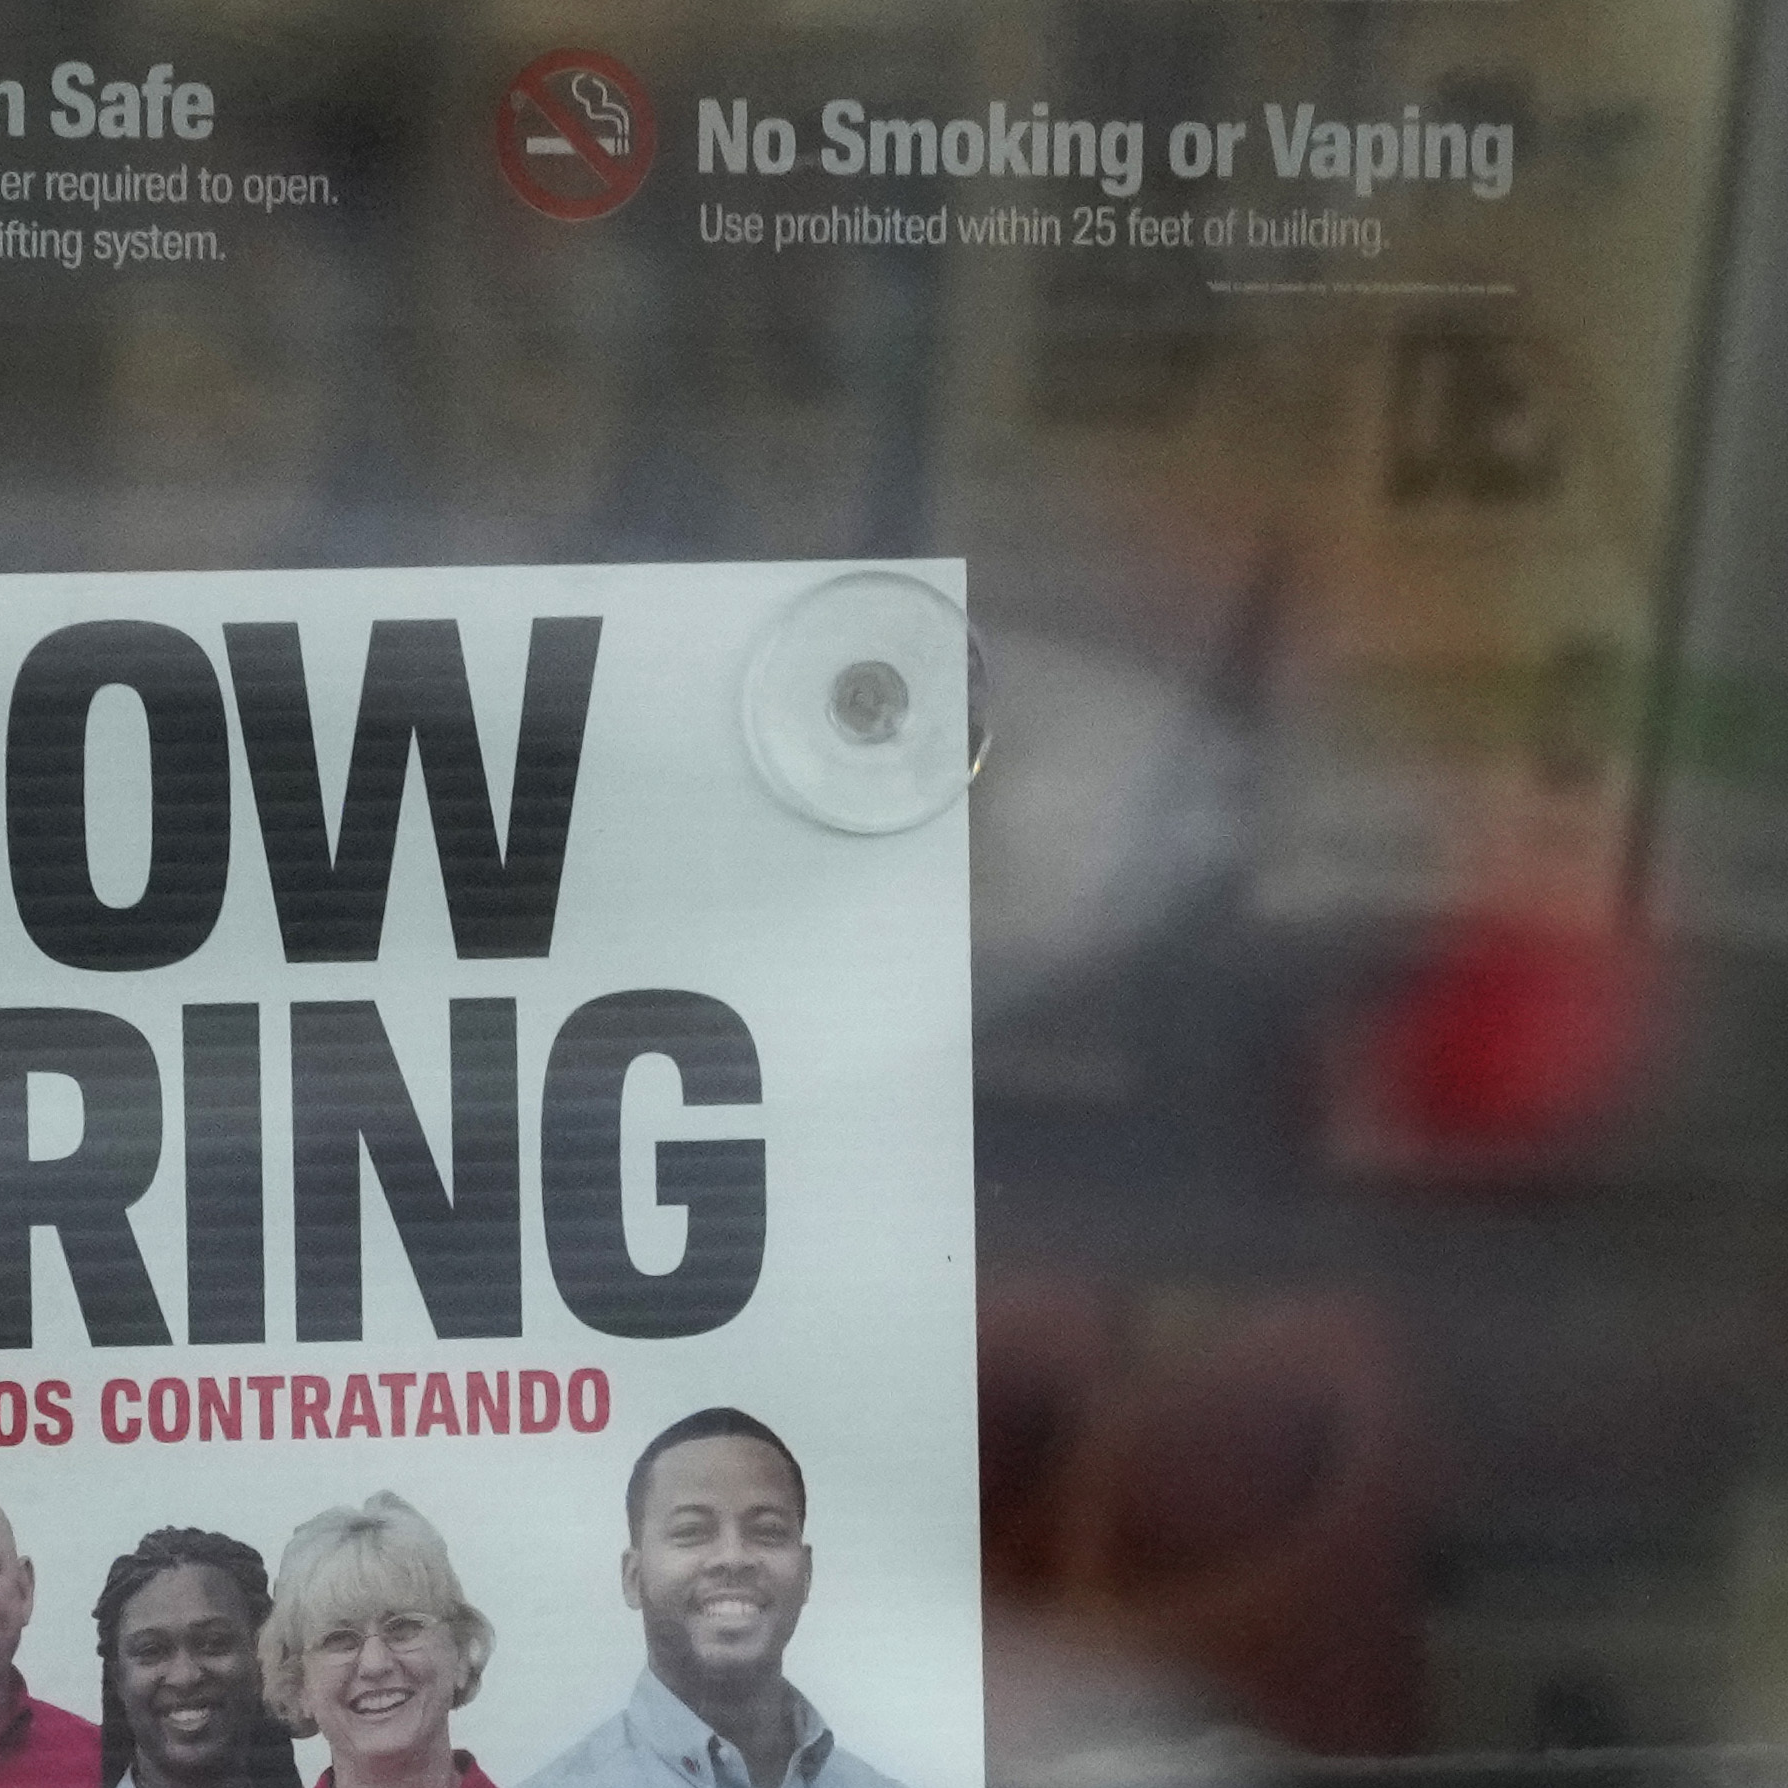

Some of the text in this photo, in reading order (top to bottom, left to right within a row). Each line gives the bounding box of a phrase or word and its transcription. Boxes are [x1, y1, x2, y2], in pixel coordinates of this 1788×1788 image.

[50, 60, 214, 140] Safe
[698, 98, 1513, 199] No Smoking or Vaping
[46, 164, 187, 210] required
[199, 168, 233, 204] to
[243, 172, 338, 213] open.
[93, 224, 227, 268] system.
[700, 203, 1390, 258] Use prohibited within 25 feet of building.
[101, 1368, 612, 1443] CONTRATANDO
